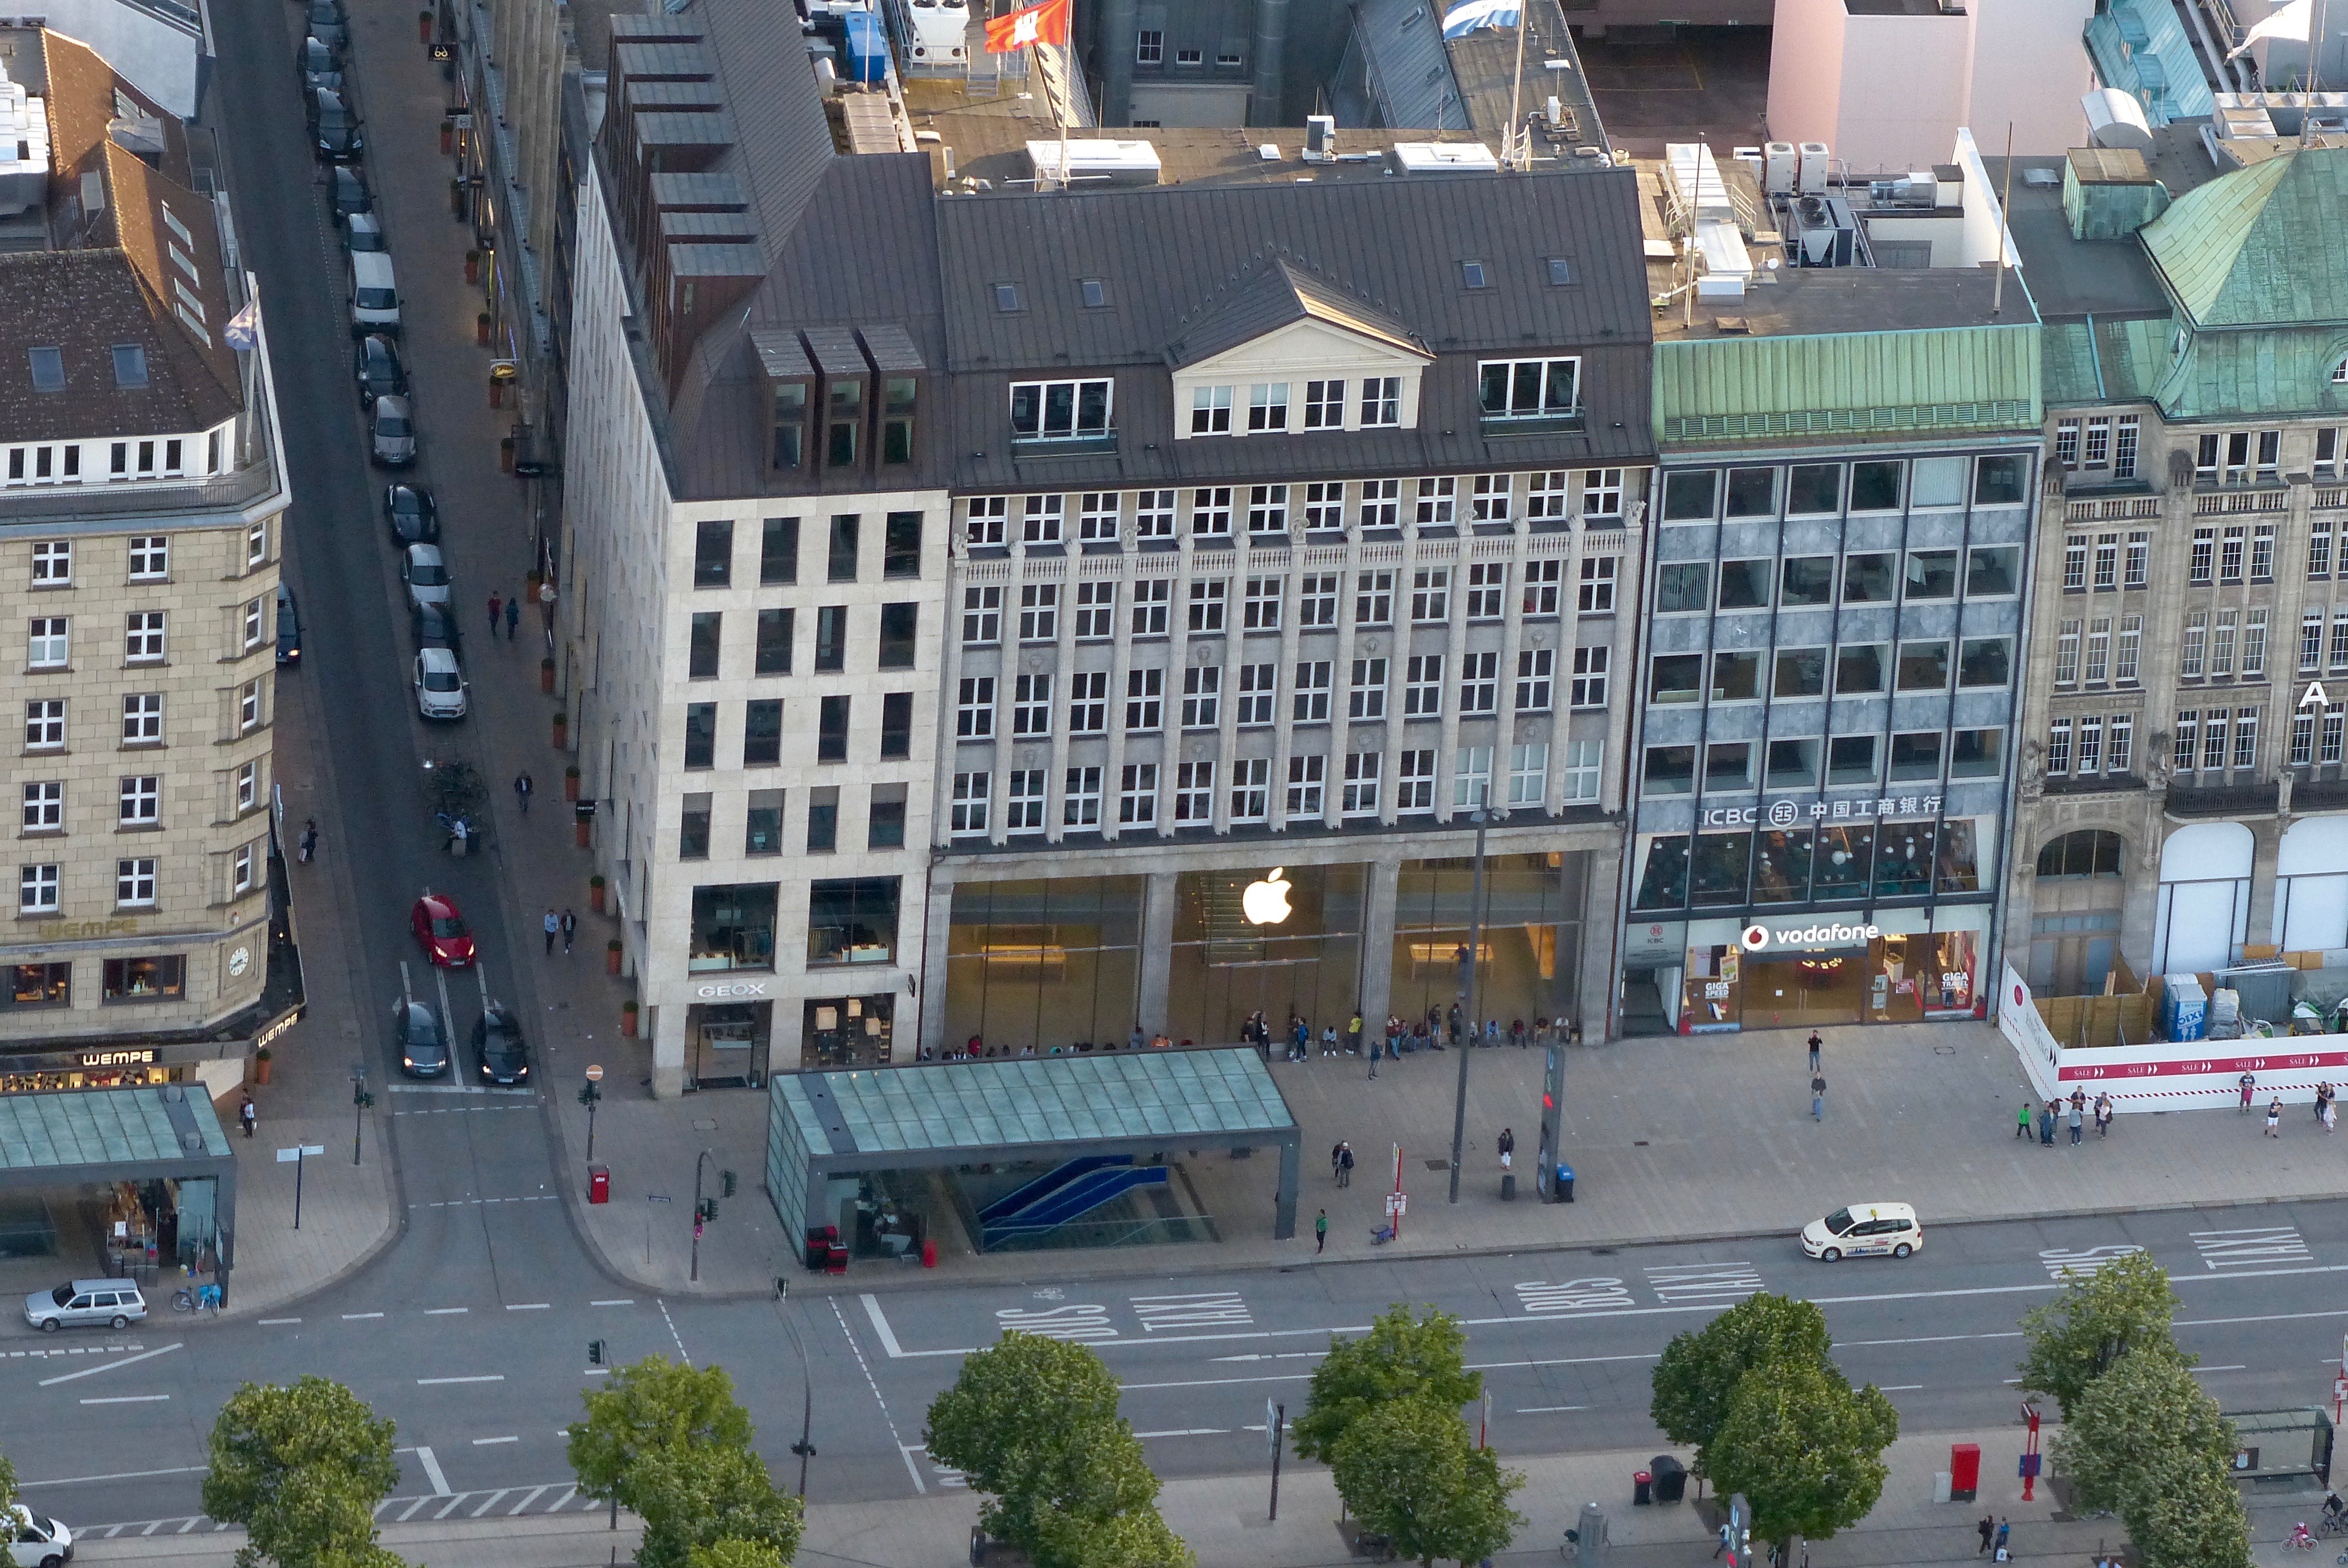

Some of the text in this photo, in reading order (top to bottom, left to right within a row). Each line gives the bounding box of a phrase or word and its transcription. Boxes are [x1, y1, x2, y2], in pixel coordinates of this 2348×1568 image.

[2299, 681, 2329, 707] A
[1703, 807, 1757, 826] ICBC
[1810, 796, 1941, 819] 中国工商银行
[39, 919, 138, 938] WEMPE
[1776, 923, 1878, 944] vodafone
[1705, 982, 1729, 991] GIGA
[1942, 972, 1969, 981] GIGA
[697, 983, 766, 997] GEOX
[258, 1012, 298, 1047] WEMPE
[83, 1050, 153, 1066] WEMPE
[2189, 1226, 2313, 1269] TAXI
[1644, 1262, 1765, 1303] TAXI
[1514, 1277, 1635, 1312] BUS
[1129, 1292, 1253, 1332] TAXI
